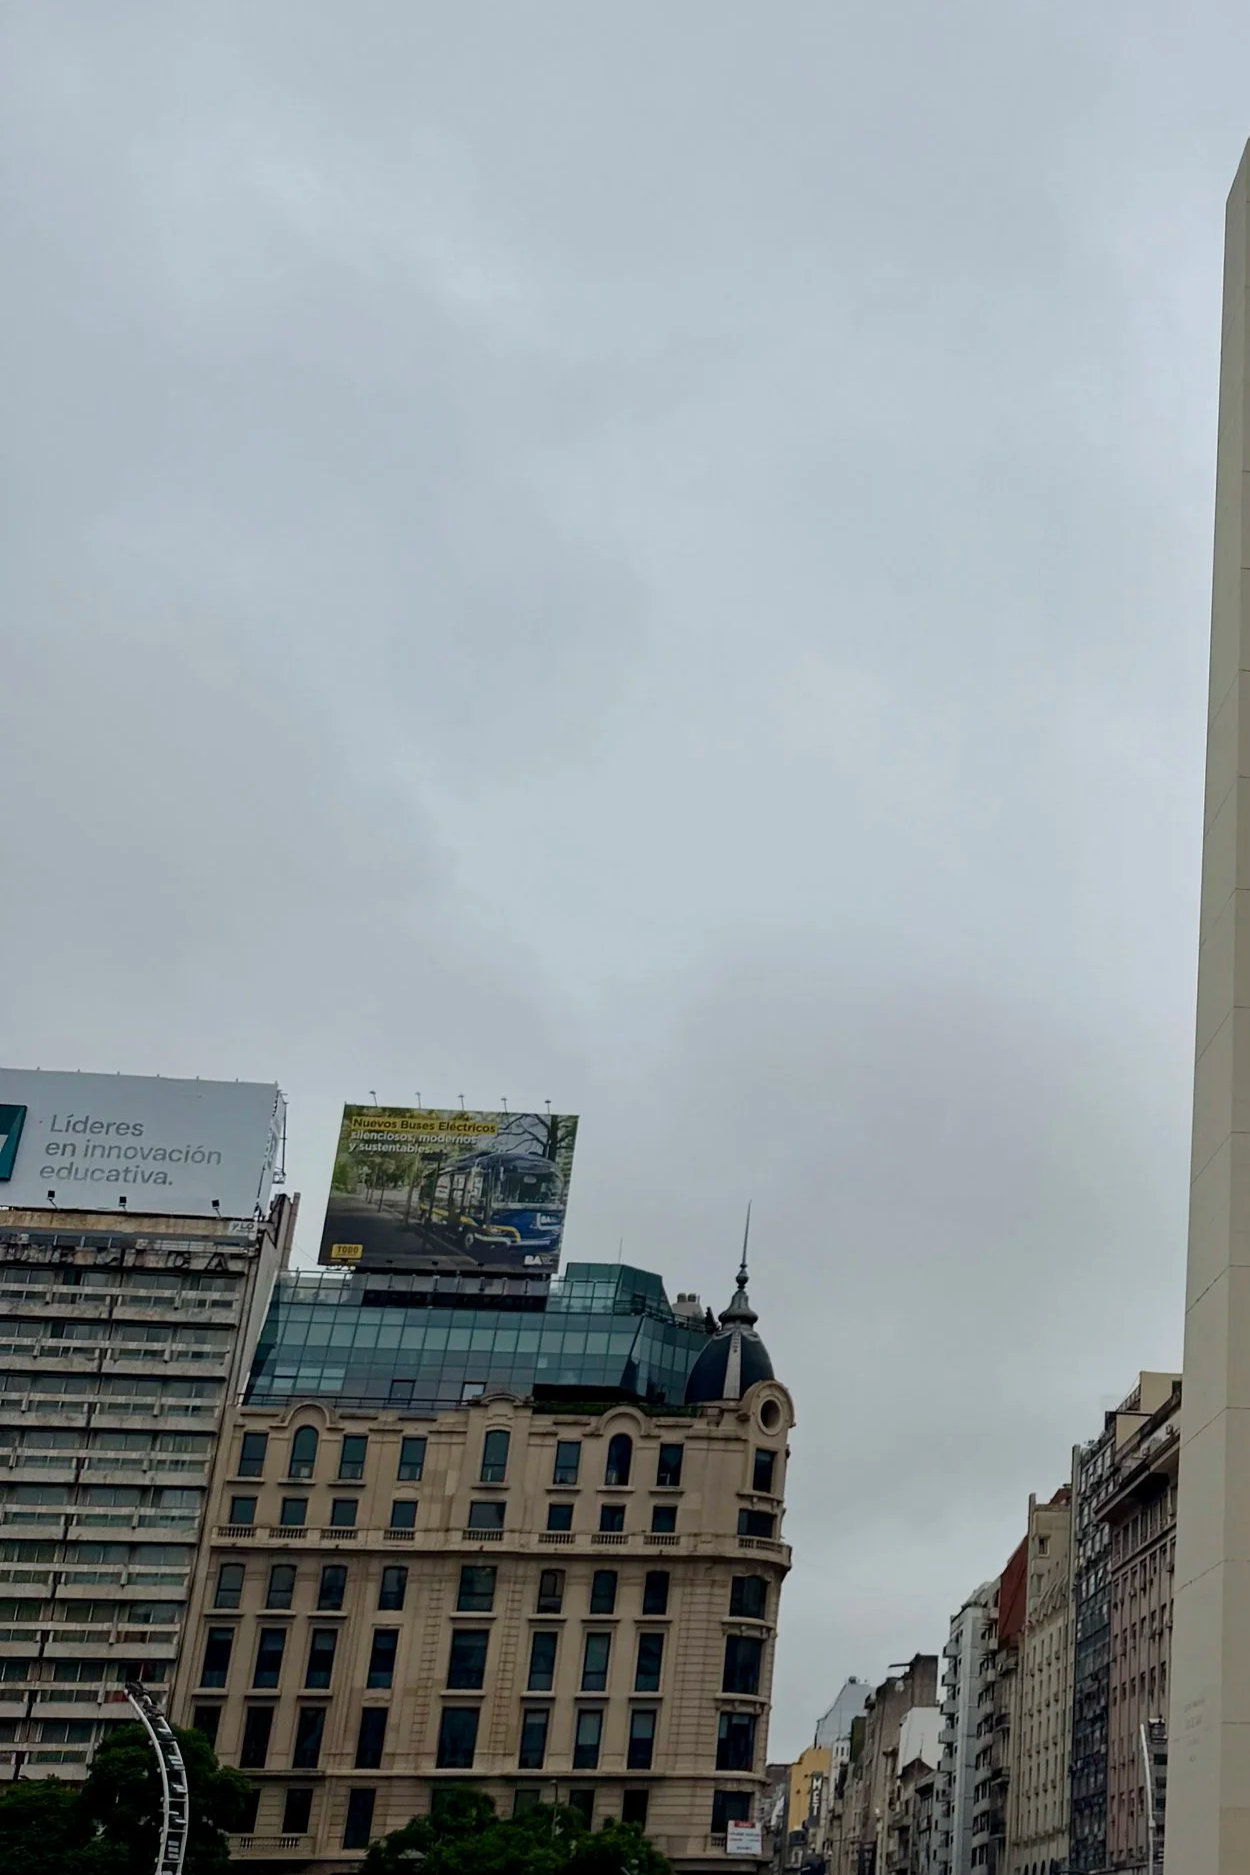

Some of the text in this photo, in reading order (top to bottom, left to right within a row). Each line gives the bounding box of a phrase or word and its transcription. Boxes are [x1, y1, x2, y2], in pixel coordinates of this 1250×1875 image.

[50, 1114, 144, 1137] Líderes
[353, 1118, 496, 1133] Nuevos Buses Eléctricos
[351, 1131, 477, 1144] silenciosos, modernos
[45, 1139, 222, 1166] en innovación
[349, 1142, 434, 1154] y sustentables.
[39, 1162, 174, 1186] educativa.
